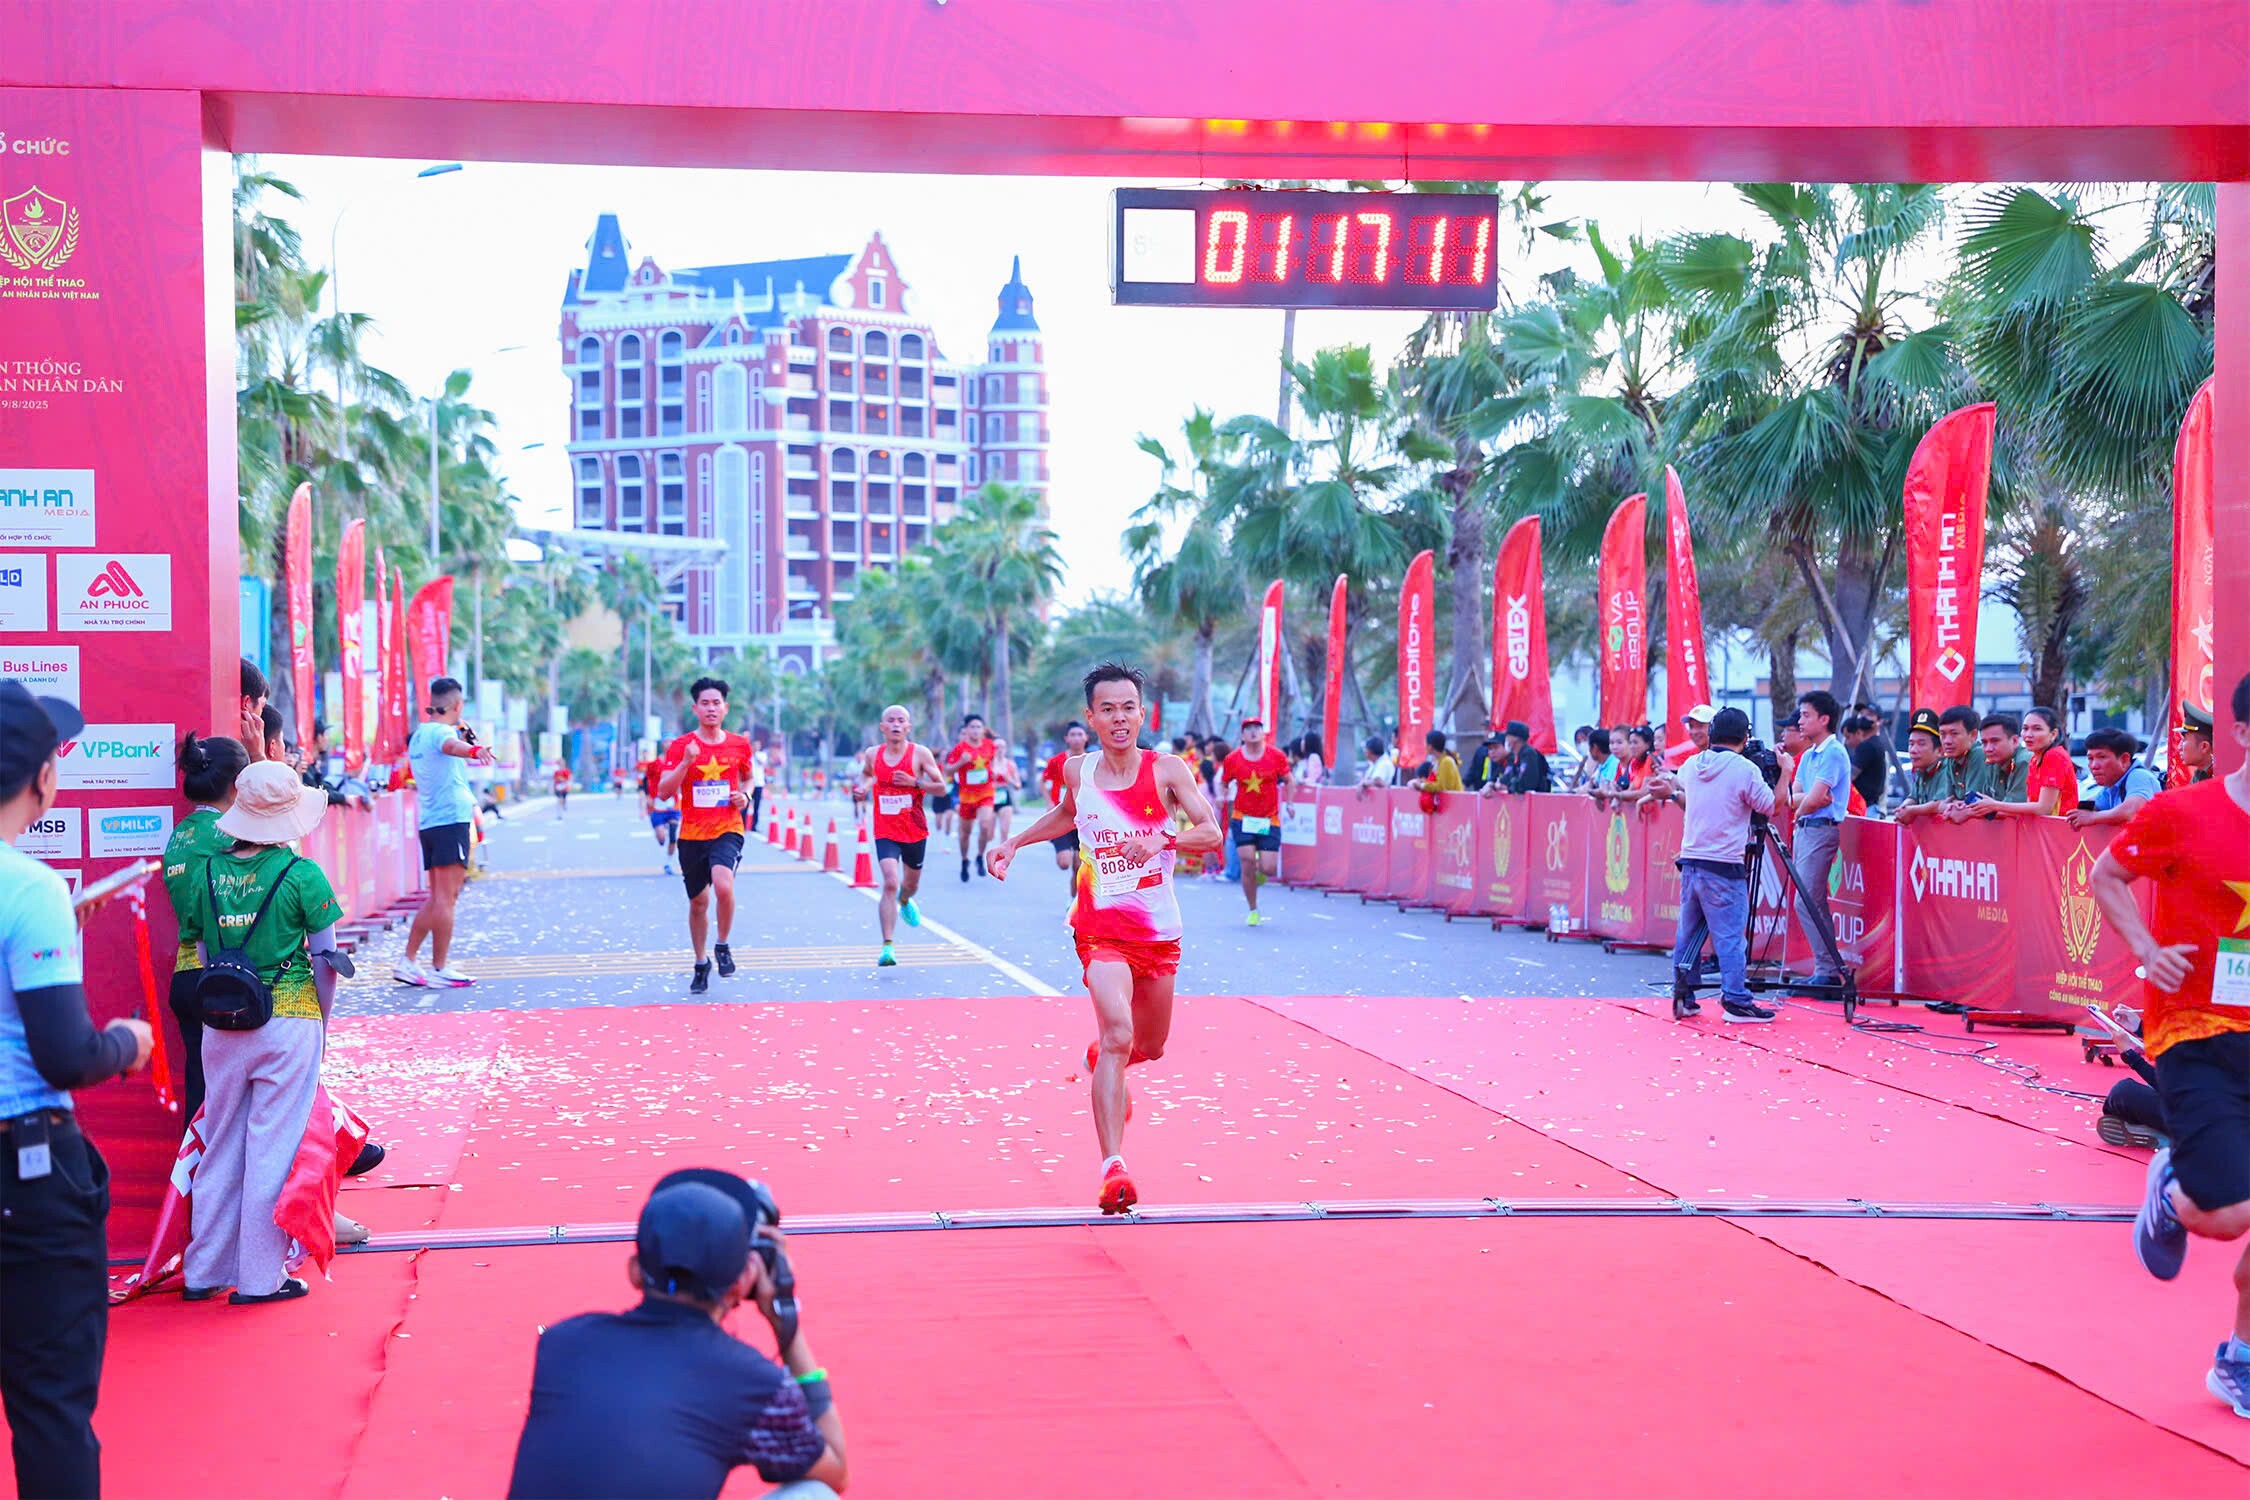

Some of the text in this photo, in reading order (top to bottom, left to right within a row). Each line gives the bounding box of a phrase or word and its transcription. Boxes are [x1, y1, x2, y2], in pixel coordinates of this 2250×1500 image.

[13, 137, 70, 155] CHỨC
[56, 278, 86, 288] THAO
[2, 290, 14, 298] AN
[12, 357, 81, 375] THỐNG
[23, 376, 78, 392] NHÂN
[83, 377, 124, 393] DÂN
[0, 400, 49, 409] 9/8/2025
[44, 489, 73, 507] AN
[44, 508, 90, 516] MEDIA
[80, 600, 150, 610] AN PHUOC
[1936, 556, 1961, 648] THANH
[3, 660, 68, 673] Bus Lines
[1405, 593, 1421, 725] mobifone
[81, 741, 161, 758] VPBank
[29, 820, 66, 833] MSB
[103, 819, 157, 831] VPMILK
[1093, 829, 1119, 845] VIỆT
[167, 862, 186, 878] CREW
[1926, 857, 1998, 902] THANH AN
[218, 912, 257, 928] CREW
[1977, 905, 2009, 923] MEDIA
